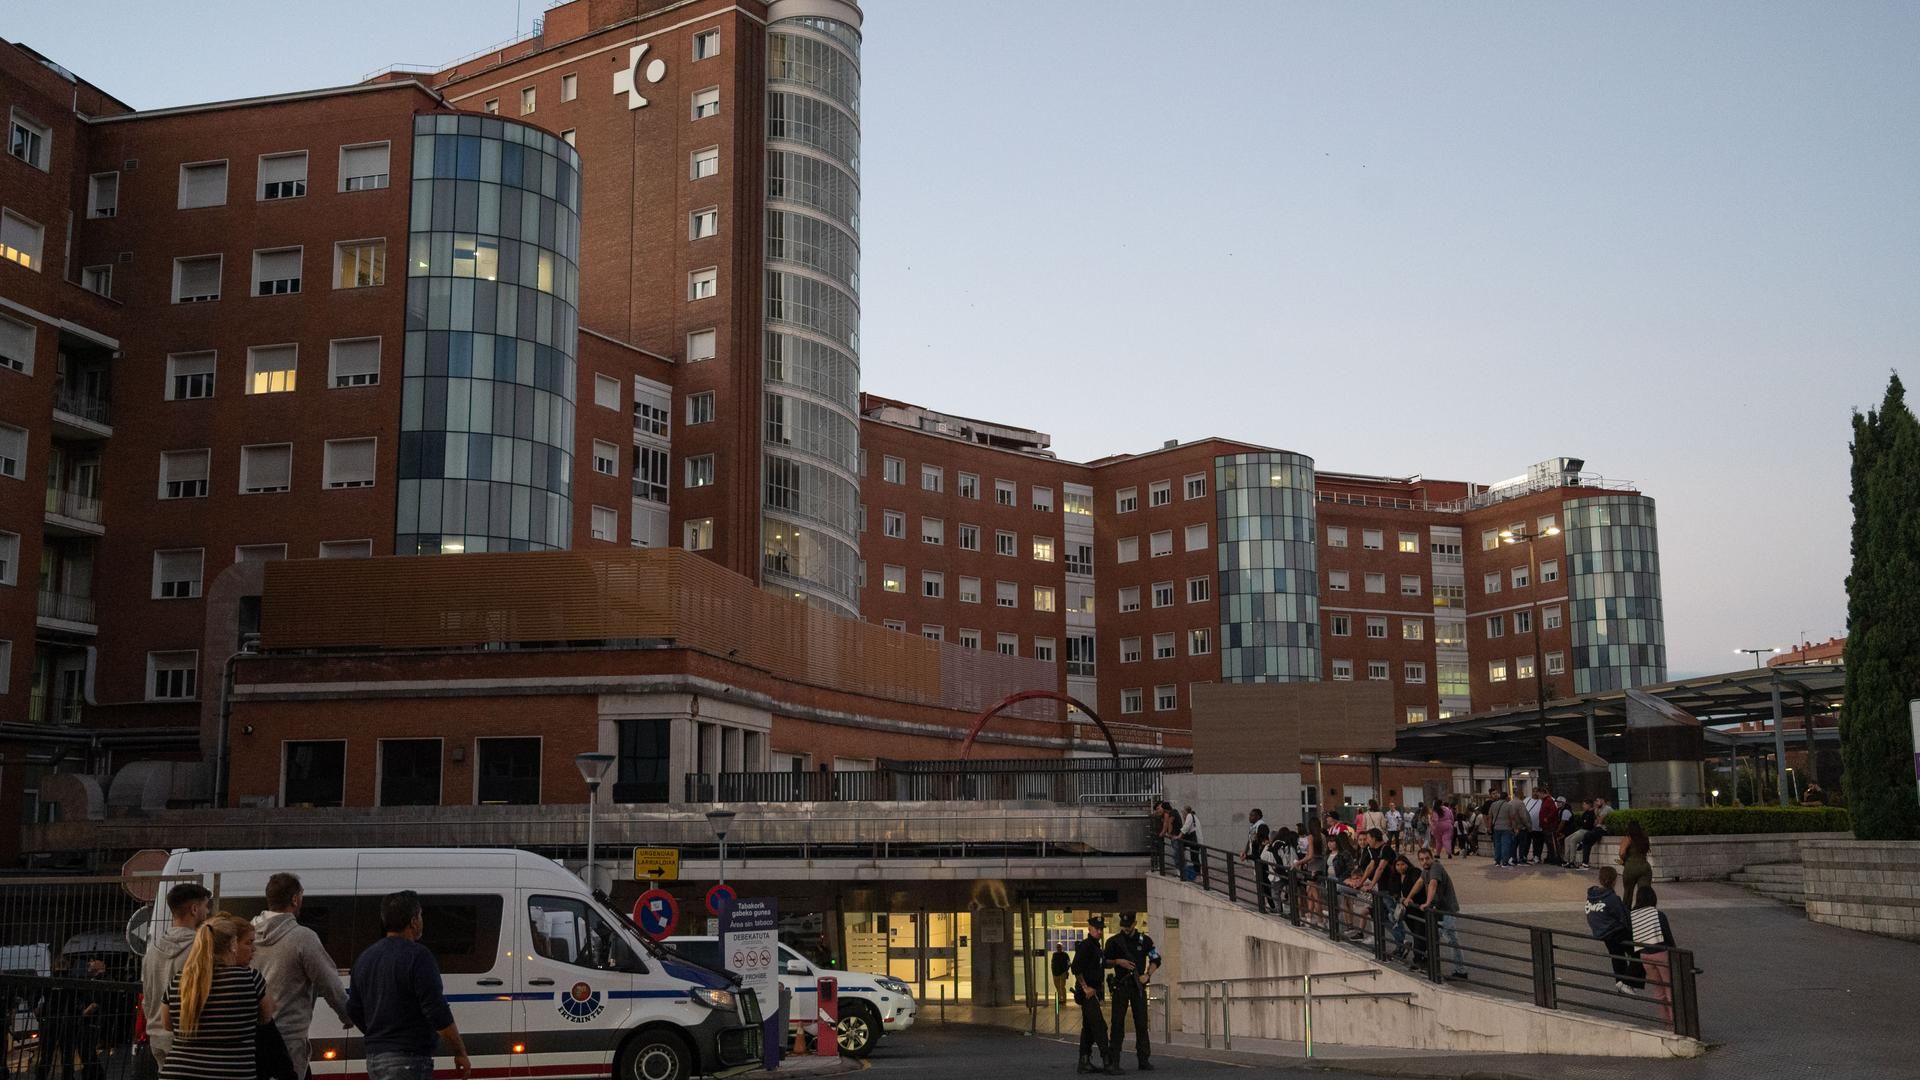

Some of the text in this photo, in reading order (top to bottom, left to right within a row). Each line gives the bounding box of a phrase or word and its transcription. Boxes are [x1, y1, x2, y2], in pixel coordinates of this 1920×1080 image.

[738, 902, 765, 910] Tabakorik
[731, 909, 771, 918] gabeko gunea
[733, 932, 770, 941] DEBEKATUTA
[558, 1005, 604, 1023] ERTZAINTZA
